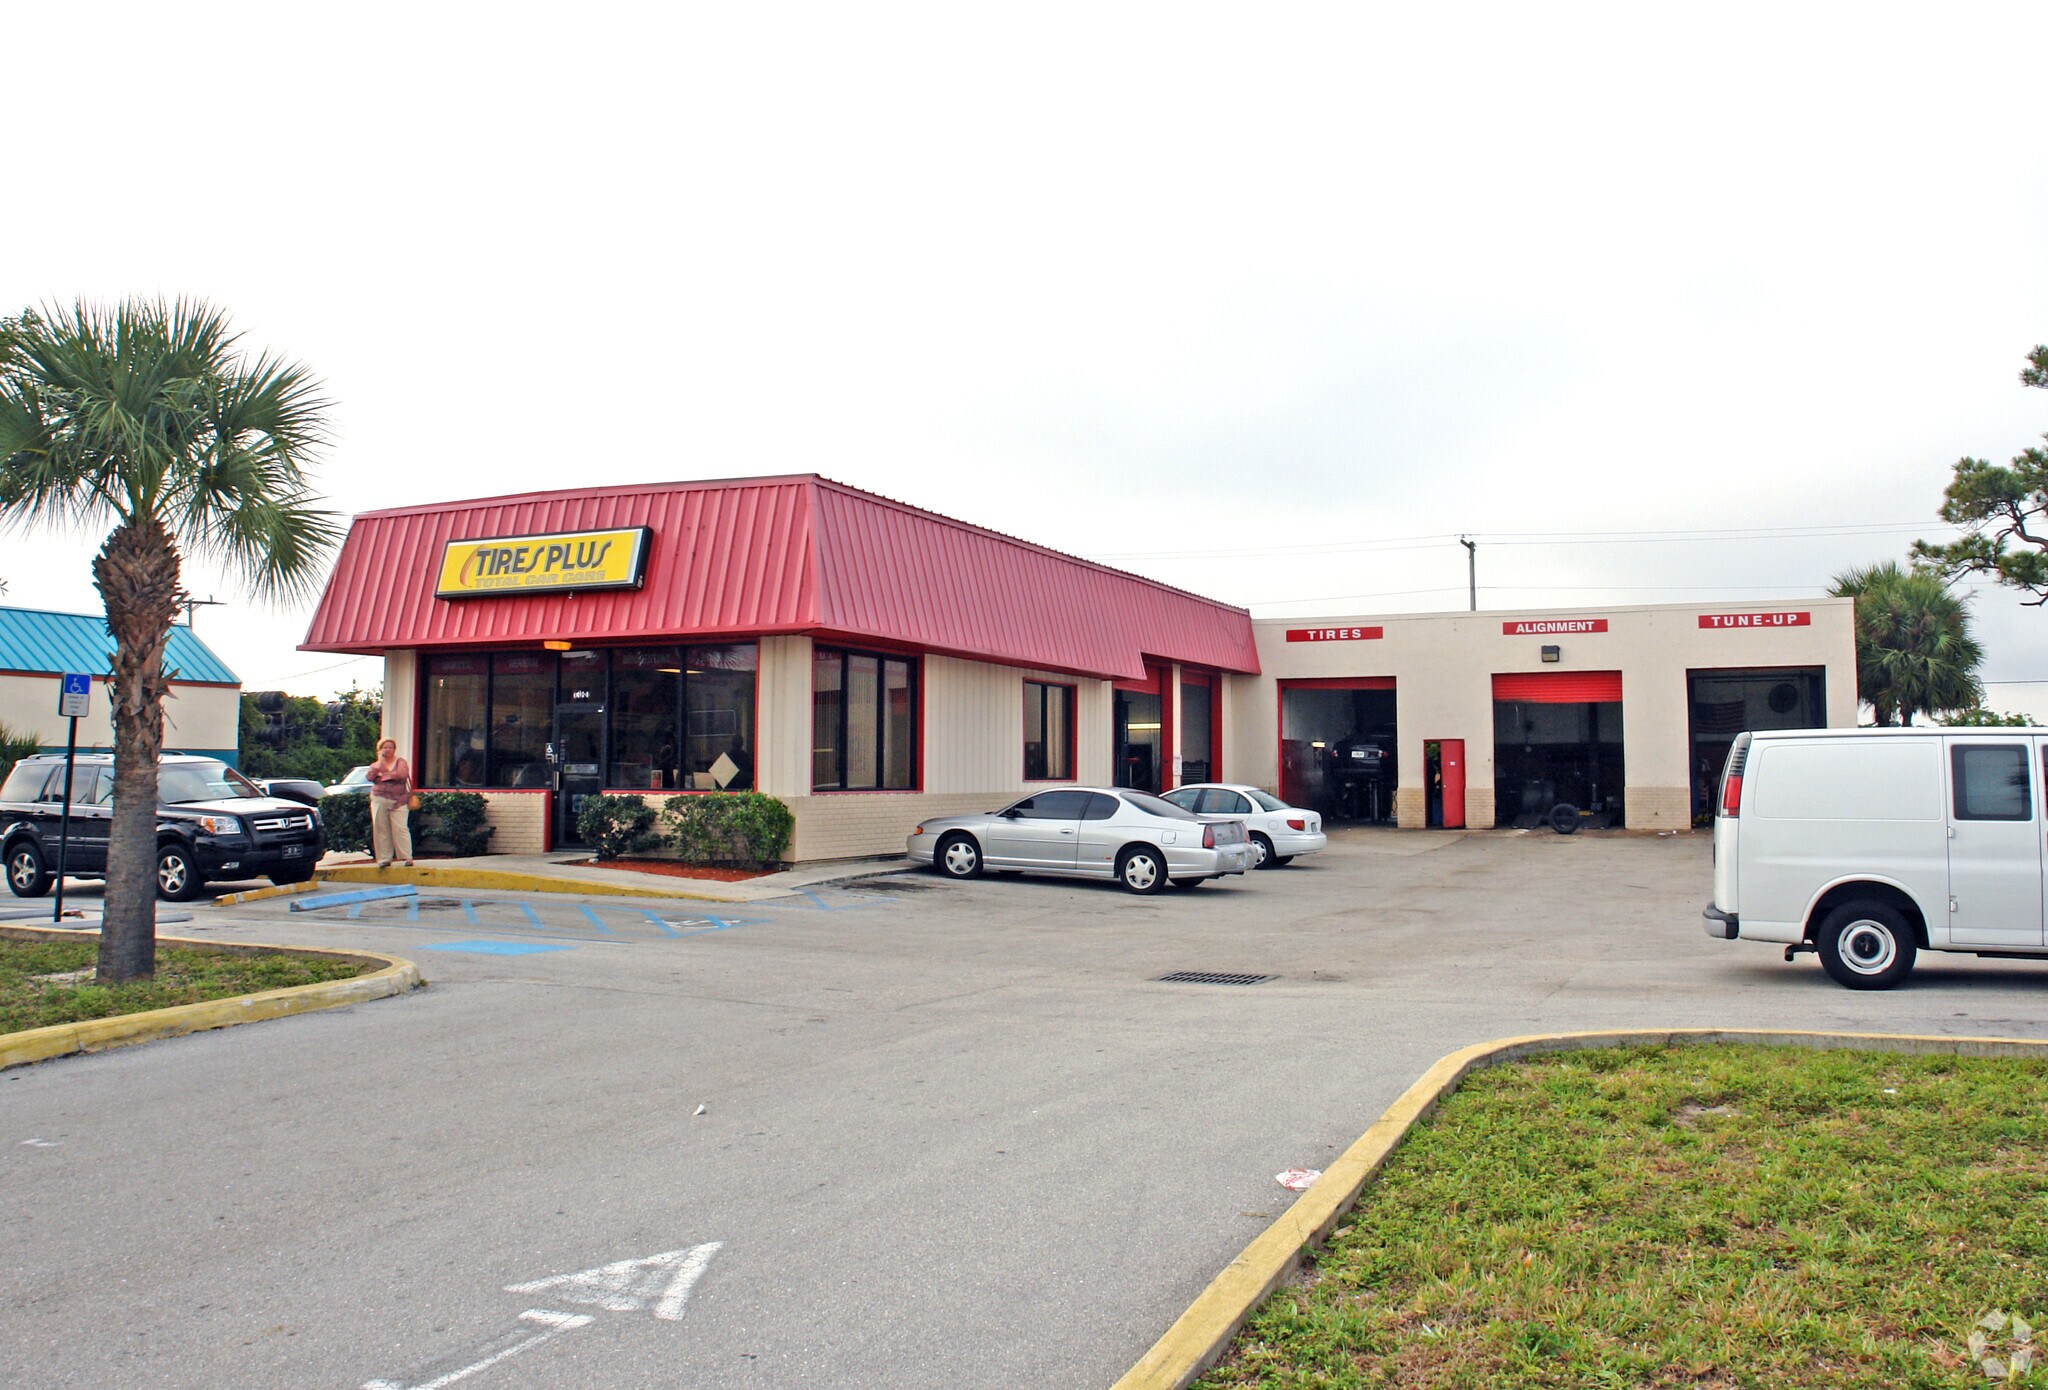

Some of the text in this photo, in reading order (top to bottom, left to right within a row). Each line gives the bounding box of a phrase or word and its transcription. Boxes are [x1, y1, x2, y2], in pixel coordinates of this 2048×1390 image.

[475, 570, 606, 588] TOTAL CAR CARE
[1711, 615, 1797, 626] TUNE-UP
[1516, 621, 1594, 633] ALIGNMENT
[1307, 629, 1361, 640] TIRES
